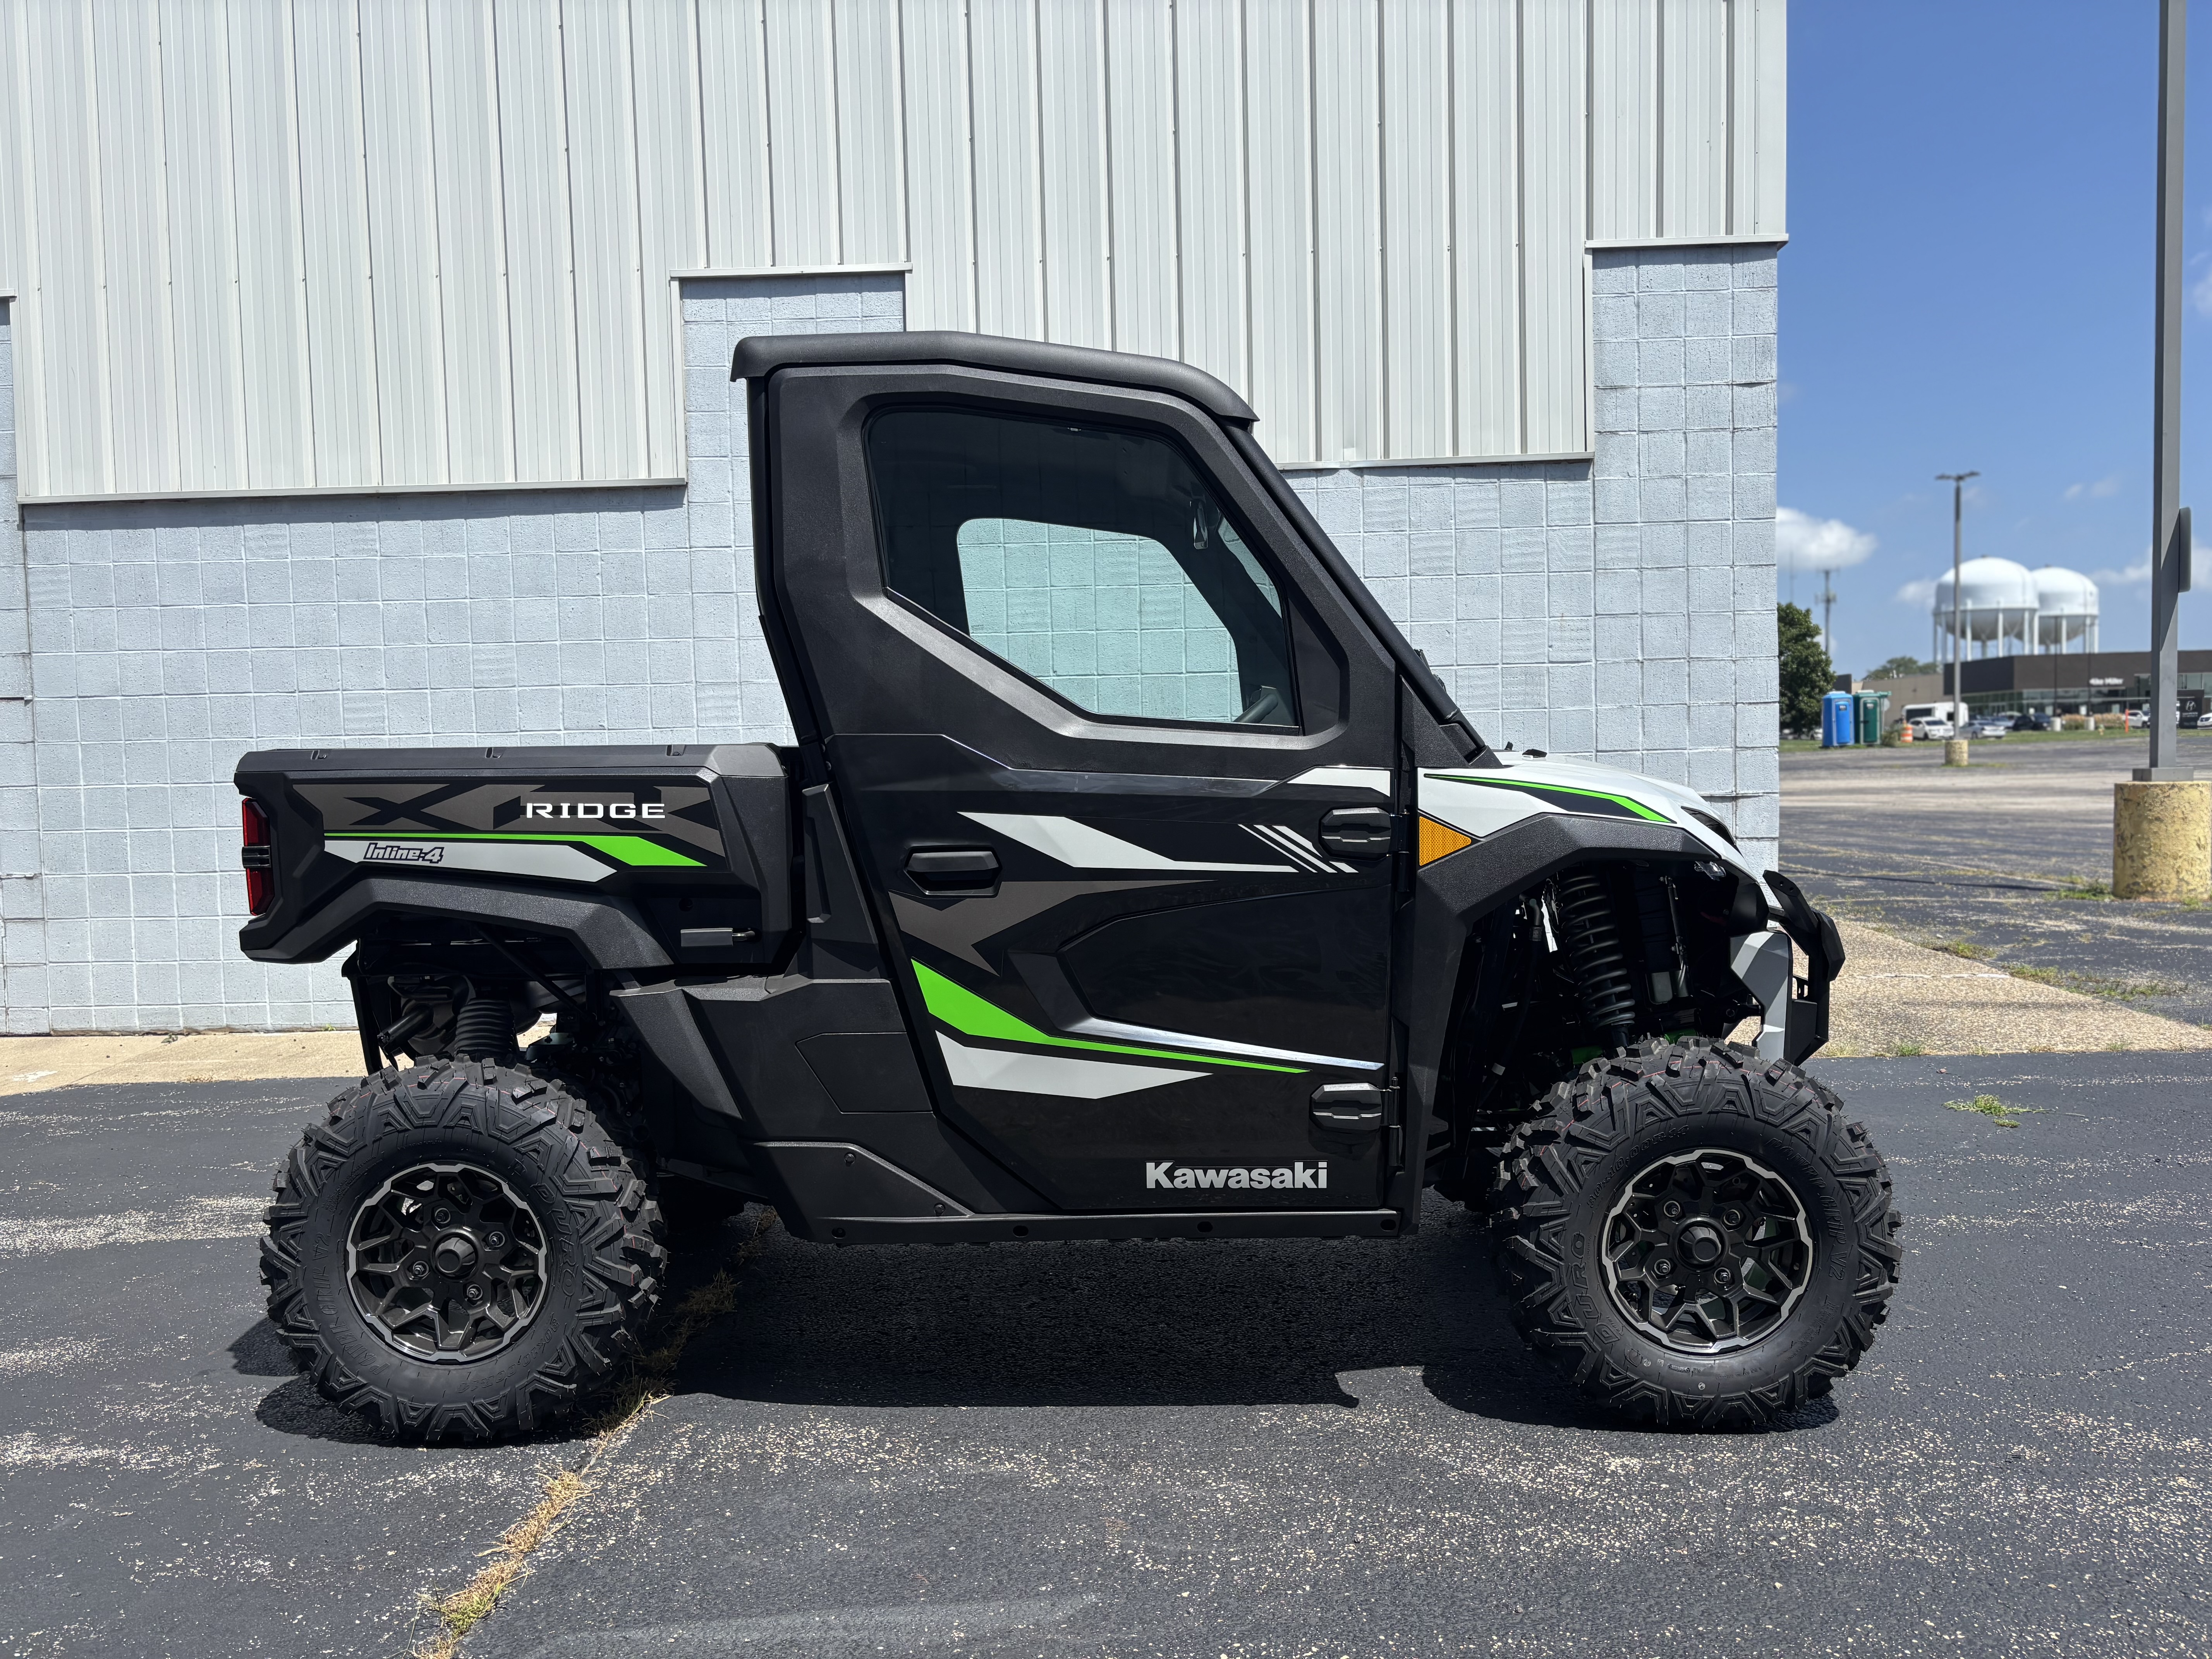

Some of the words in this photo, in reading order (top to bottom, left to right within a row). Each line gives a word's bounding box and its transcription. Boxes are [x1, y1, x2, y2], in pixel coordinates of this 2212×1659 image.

[526, 803, 665, 818] RIDGE
[363, 842, 445, 864] Inline-4
[1146, 1162, 1327, 1189] Kawasaki
[530, 1183, 576, 1297] DURO
[1819, 1195, 1847, 1244] GRIP
[1571, 1231, 1620, 1344] DURO
[1829, 1251, 1847, 1280] V2
[313, 1267, 338, 1315] GRIP
[330, 1322, 390, 1375] POWER
